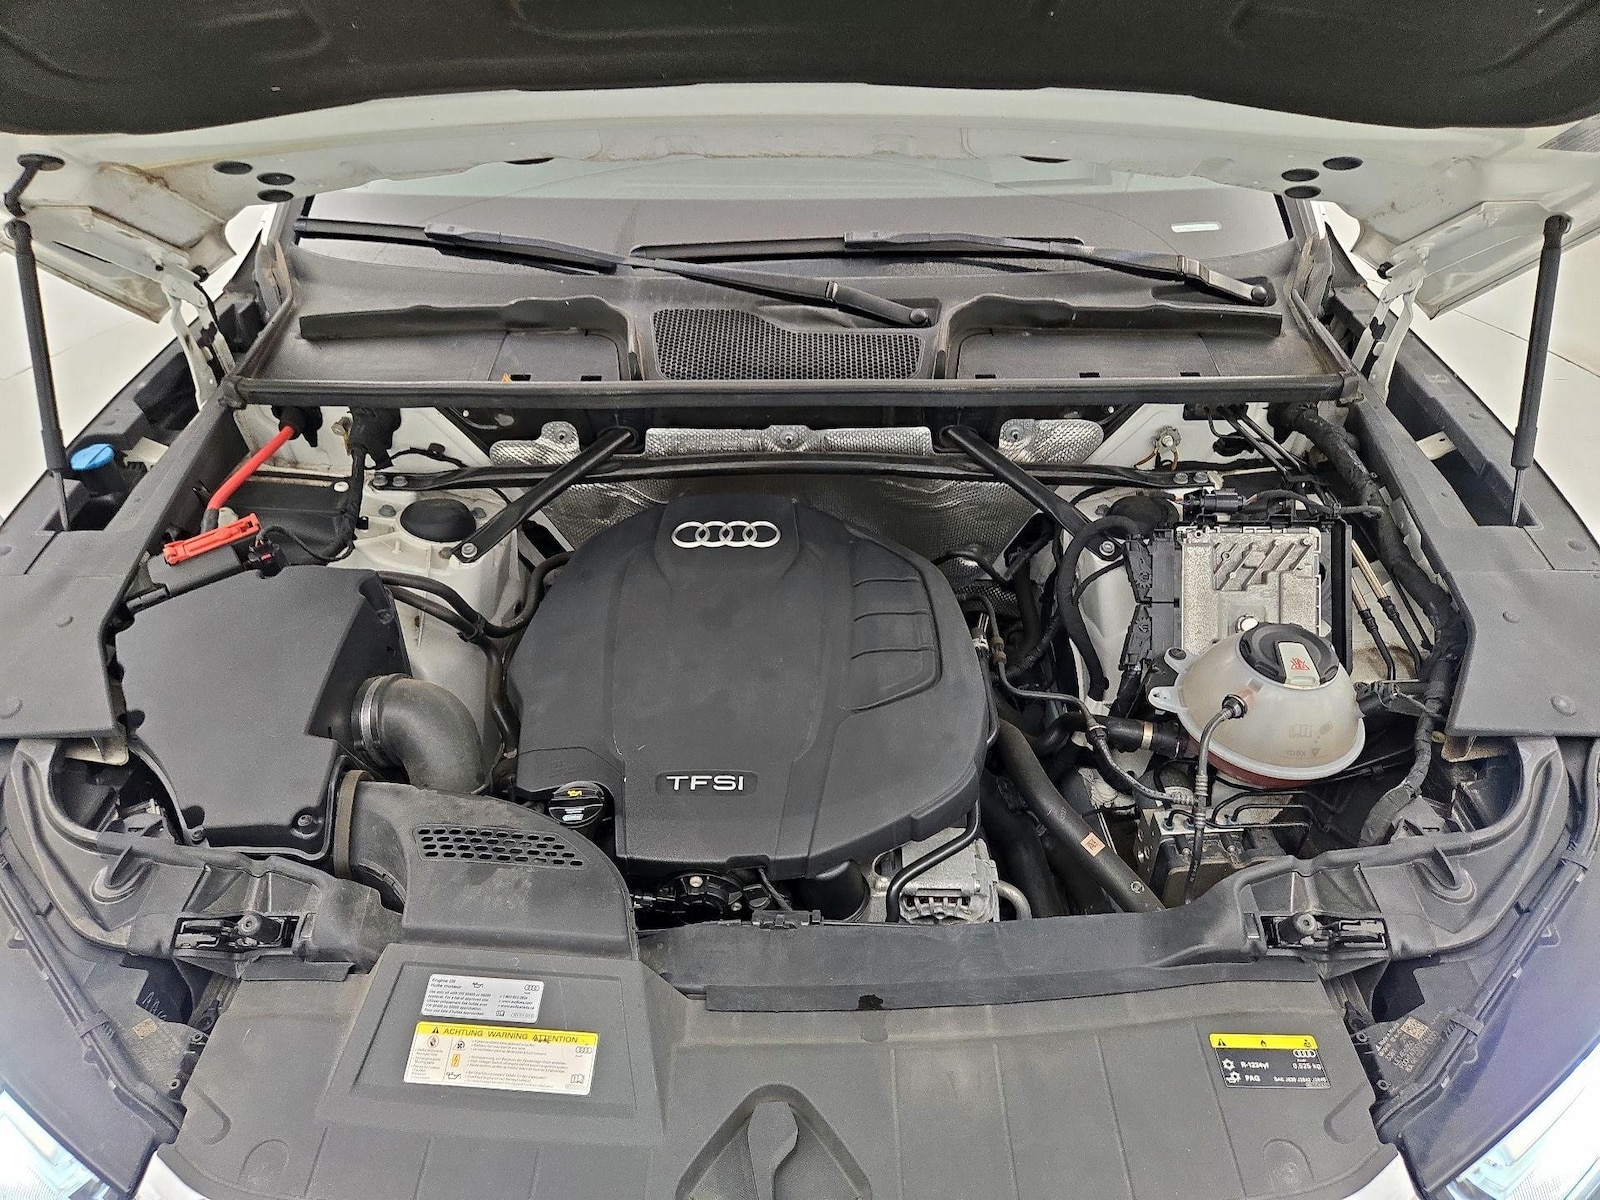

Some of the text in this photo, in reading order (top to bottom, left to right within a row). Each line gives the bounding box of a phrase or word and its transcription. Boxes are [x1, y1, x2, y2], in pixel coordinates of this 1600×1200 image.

[666, 775, 744, 791] TFSI
[443, 1028, 578, 1043] ACHTUNG WARNING ATTENTION
